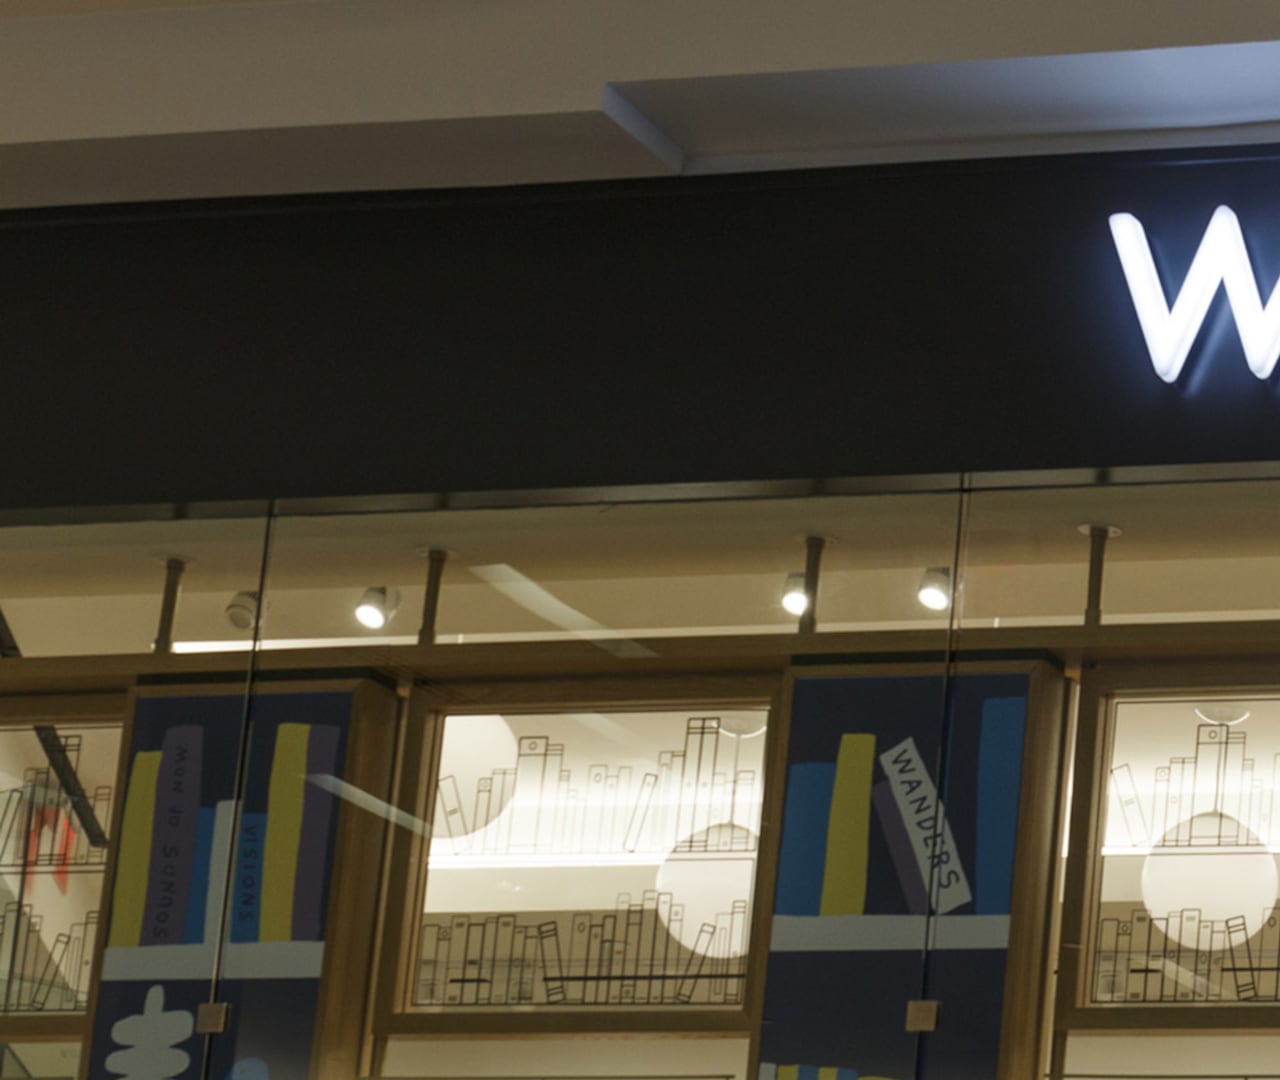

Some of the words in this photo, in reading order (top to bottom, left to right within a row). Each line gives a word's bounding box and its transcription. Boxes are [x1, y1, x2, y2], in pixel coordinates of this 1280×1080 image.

[893, 749, 960, 890] WANDERS
[154, 846, 180, 937] SOUNDS
[239, 825, 257, 920] VISIONS
